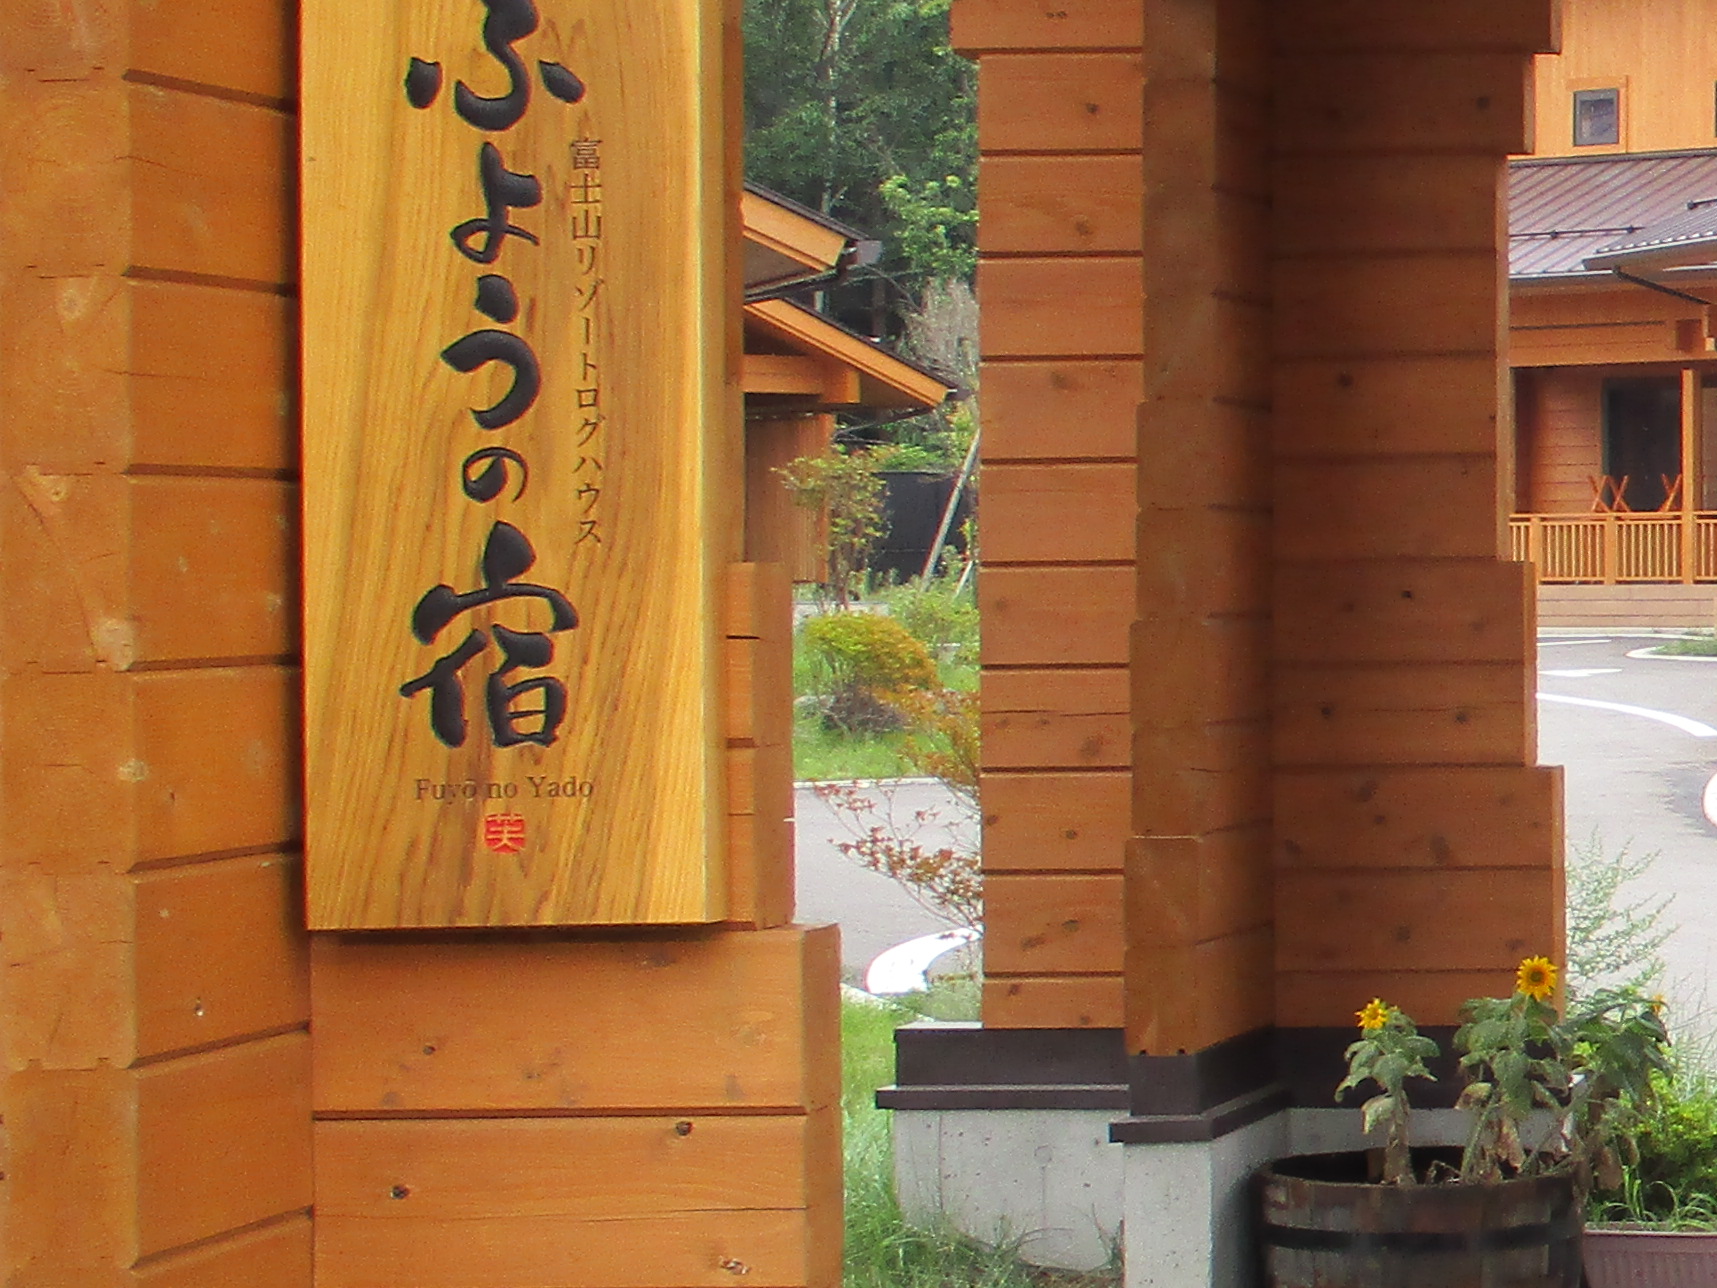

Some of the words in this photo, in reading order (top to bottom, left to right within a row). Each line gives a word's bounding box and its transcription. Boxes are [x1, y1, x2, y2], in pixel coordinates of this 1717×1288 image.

[569, 136, 605, 545] 富士山リゾートログハウス
[488, 782, 518, 799] no
[525, 775, 595, 799] Yado
